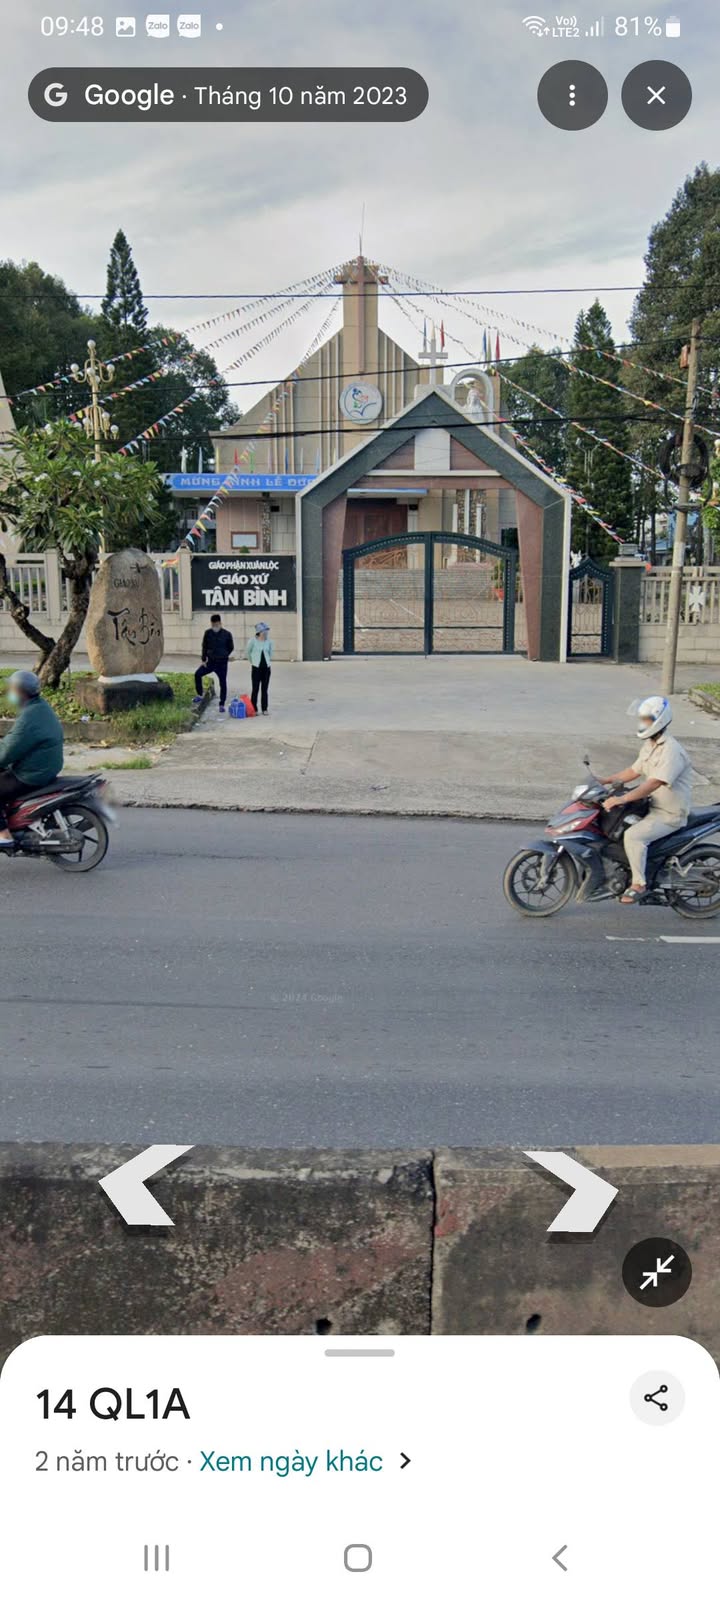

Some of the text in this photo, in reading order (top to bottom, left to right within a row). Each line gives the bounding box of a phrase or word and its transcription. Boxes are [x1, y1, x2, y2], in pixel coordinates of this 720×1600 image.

[208, 560, 226, 570] GIÁO
[218, 572, 270, 585] GIÁO XỨ
[202, 586, 287, 606] TÂN BÌNH
